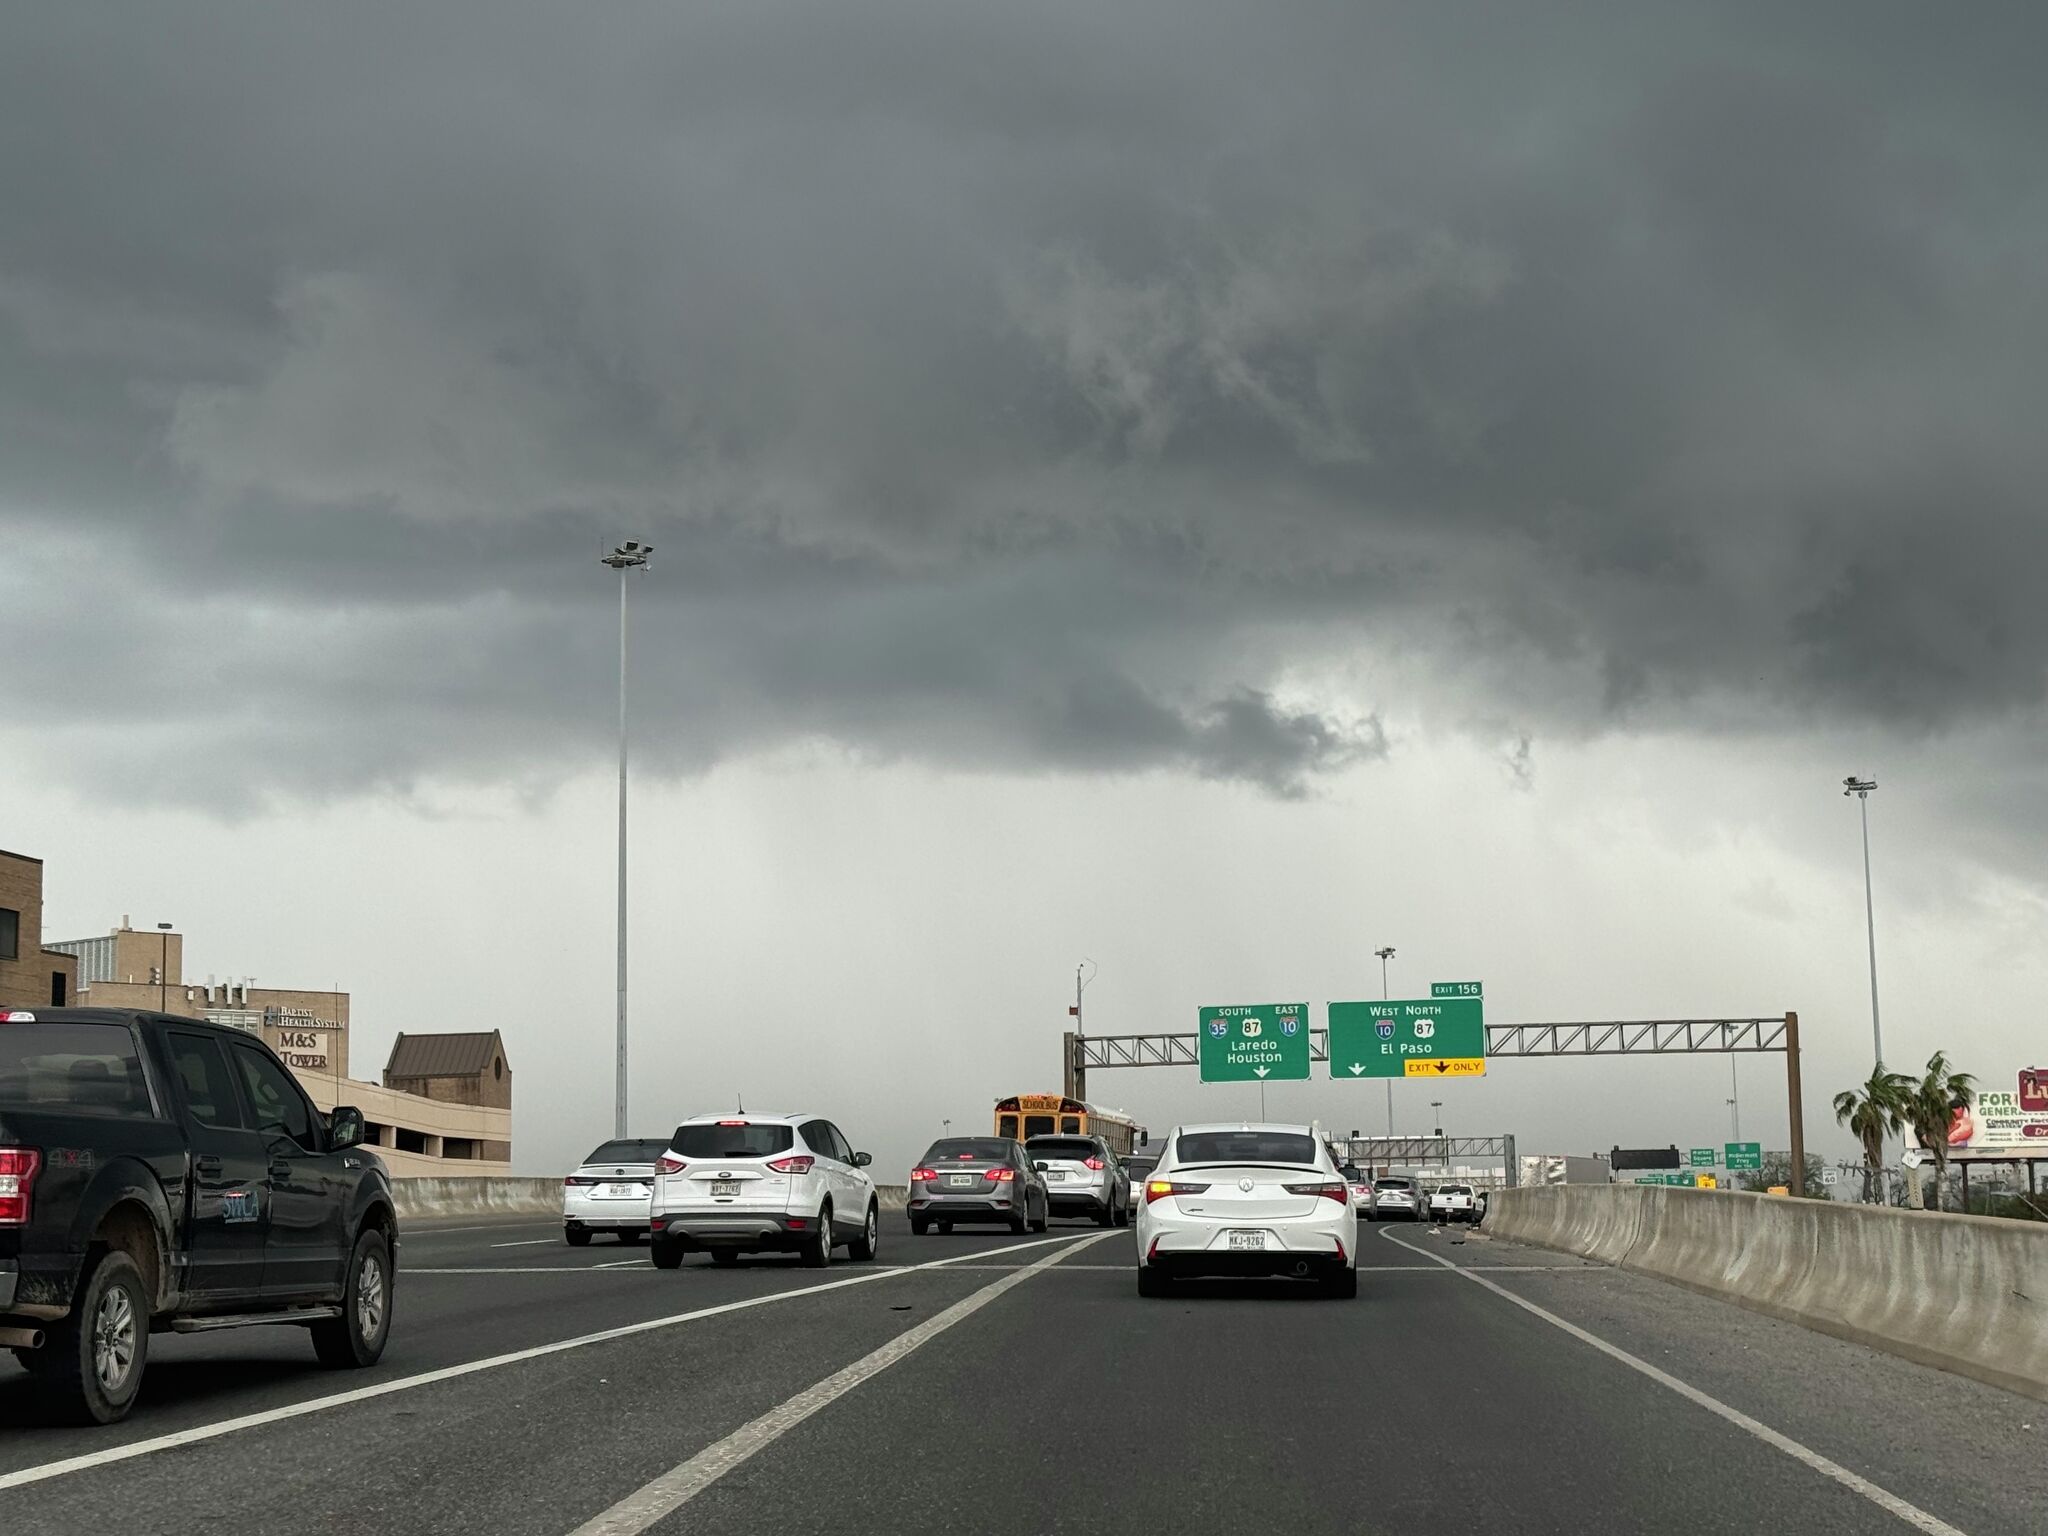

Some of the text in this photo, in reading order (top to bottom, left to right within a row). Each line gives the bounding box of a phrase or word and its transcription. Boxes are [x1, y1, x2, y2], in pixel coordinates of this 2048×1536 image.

[1435, 984, 1478, 994] EXIT 156
[281, 1006, 314, 1018] BAPTIST
[1218, 1006, 1299, 1017] SOUTH EAST
[1369, 1005, 1442, 1017] WEST NORTH
[1211, 1023, 1227, 1036] 35
[1244, 1022, 1260, 1033] 87
[1283, 1021, 1297, 1033] 10
[1379, 1025, 1392, 1036] 10
[1416, 1023, 1432, 1035] 87
[280, 1032, 316, 1048] M&S
[1231, 1040, 1277, 1052] Laredo
[1381, 1043, 1432, 1054] El Paso
[280, 1051, 327, 1068] TOWER
[1227, 1052, 1282, 1063] Houston
[1408, 1062, 1480, 1072] EXIT ONLY
[1979, 1093, 2012, 1106] FOR
